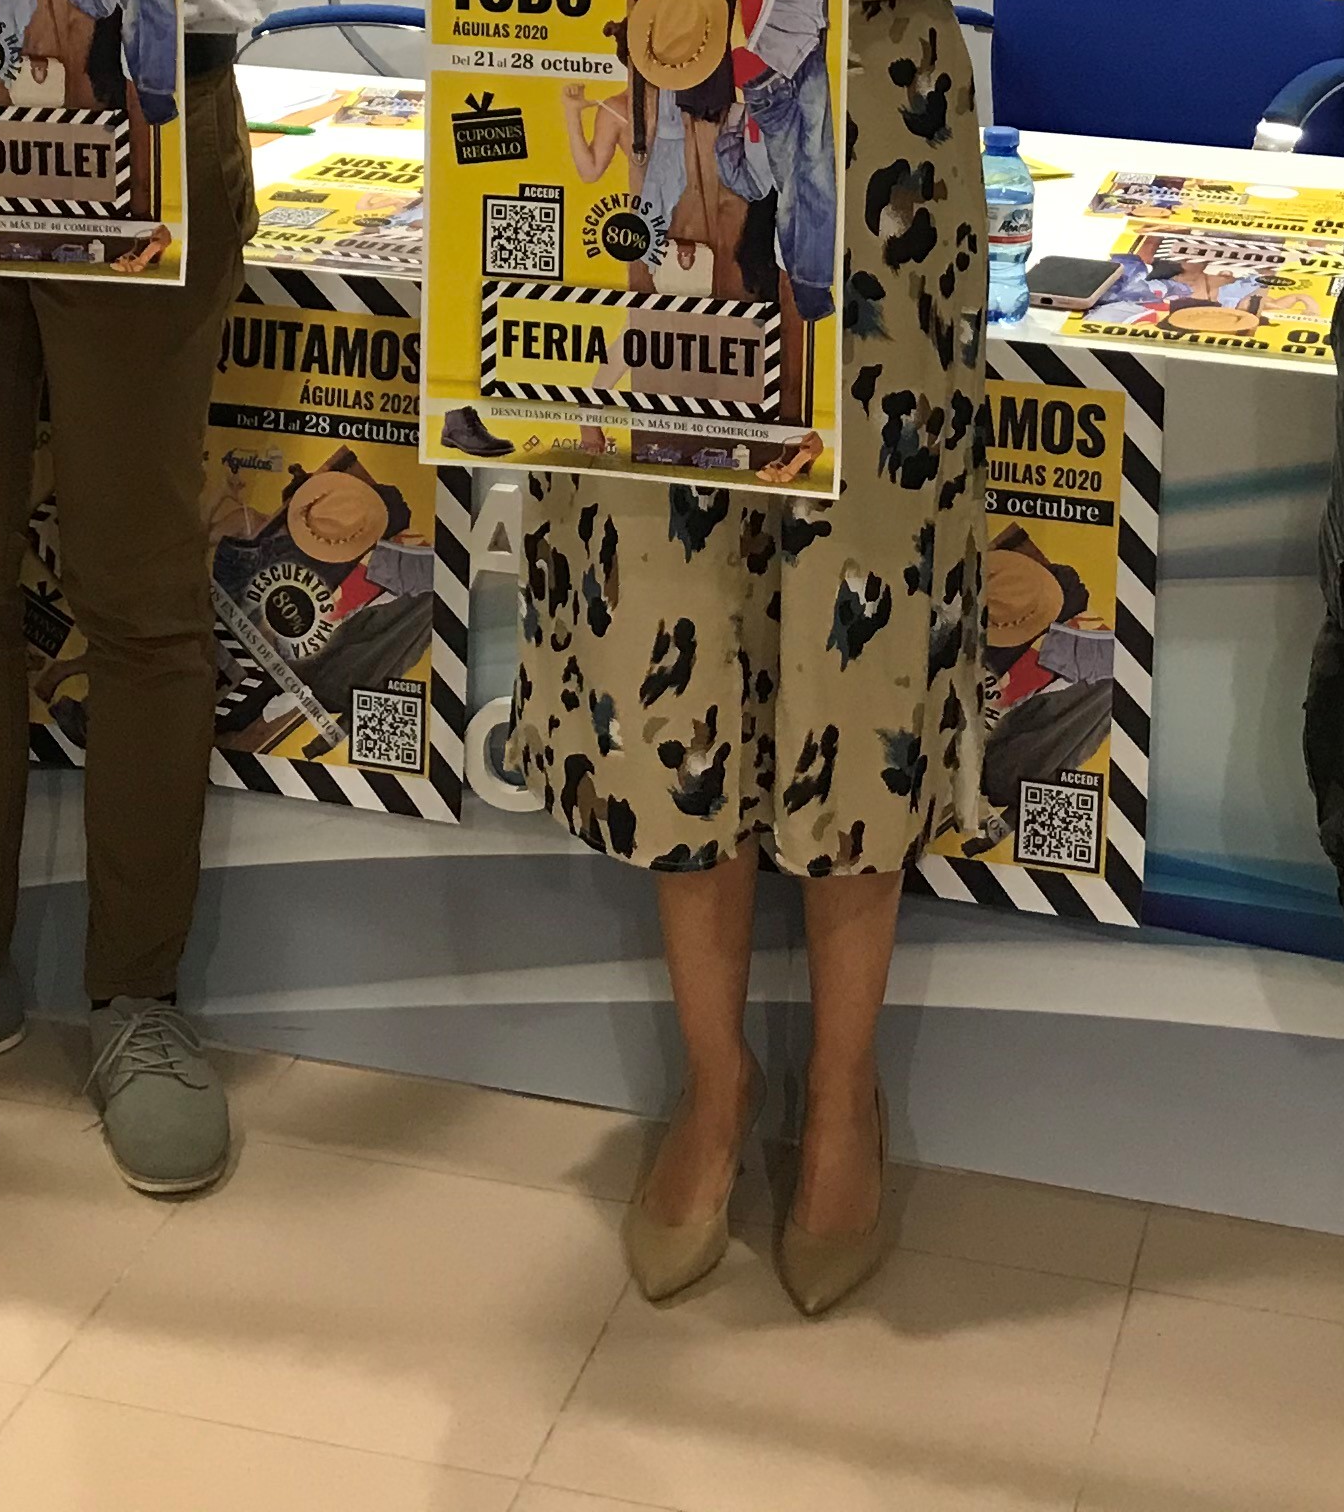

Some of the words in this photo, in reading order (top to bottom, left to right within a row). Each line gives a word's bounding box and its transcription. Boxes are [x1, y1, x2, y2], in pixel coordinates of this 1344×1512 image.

[453, 16, 510, 38] ÁGUILAS
[515, 23, 548, 41] 2020
[4, 33, 23, 81] HASTA
[452, 54, 470, 66] Del
[474, 50, 494, 67] 21
[497, 57, 506, 67] al
[511, 52, 534, 69] 28
[541, 56, 613, 74] octubre
[456, 124, 522, 143] CUPONES
[462, 140, 521, 159] REGALO
[314, 166, 420, 183] TODO
[331, 157, 393, 170] NOS
[524, 187, 560, 199] ACCEDE
[257, 230, 325, 244] ERIA
[334, 239, 422, 254] OUTLE
[582, 193, 653, 258] DESCUENTOS
[649, 214, 669, 267] HASTA
[606, 226, 646, 249] 80%
[502, 319, 608, 364] FERIA
[623, 328, 760, 377] OUTLET
[1079, 323, 1269, 350] QUITAMOS
[300, 380, 374, 411] ÁGUILAS
[263, 410, 285, 428] 21
[288, 417, 300, 431] al
[304, 414, 330, 434] 28
[339, 420, 419, 444] octubre
[490, 406, 562, 421] DESNUDAMOS
[564, 412, 583, 423] LOS
[586, 414, 629, 426] PRECIOS
[631, 418, 645, 427] EN
[648, 417, 670, 431] MÁS
[673, 422, 688, 432] DE
[691, 423, 702, 433] 40
[705, 424, 769, 439] COMERCIOS
[1053, 467, 1101, 492] 2020
[1007, 497, 1099, 521] octubre
[247, 564, 334, 613] DESCUENTOS
[291, 620, 333, 658] HASTA
[273, 591, 305, 634] 80%
[257, 644, 272, 663] DE
[285, 675, 340, 741] COMERCIOS
[388, 680, 421, 694] ACCEDE
[1061, 771, 1099, 786] ACCEDE
